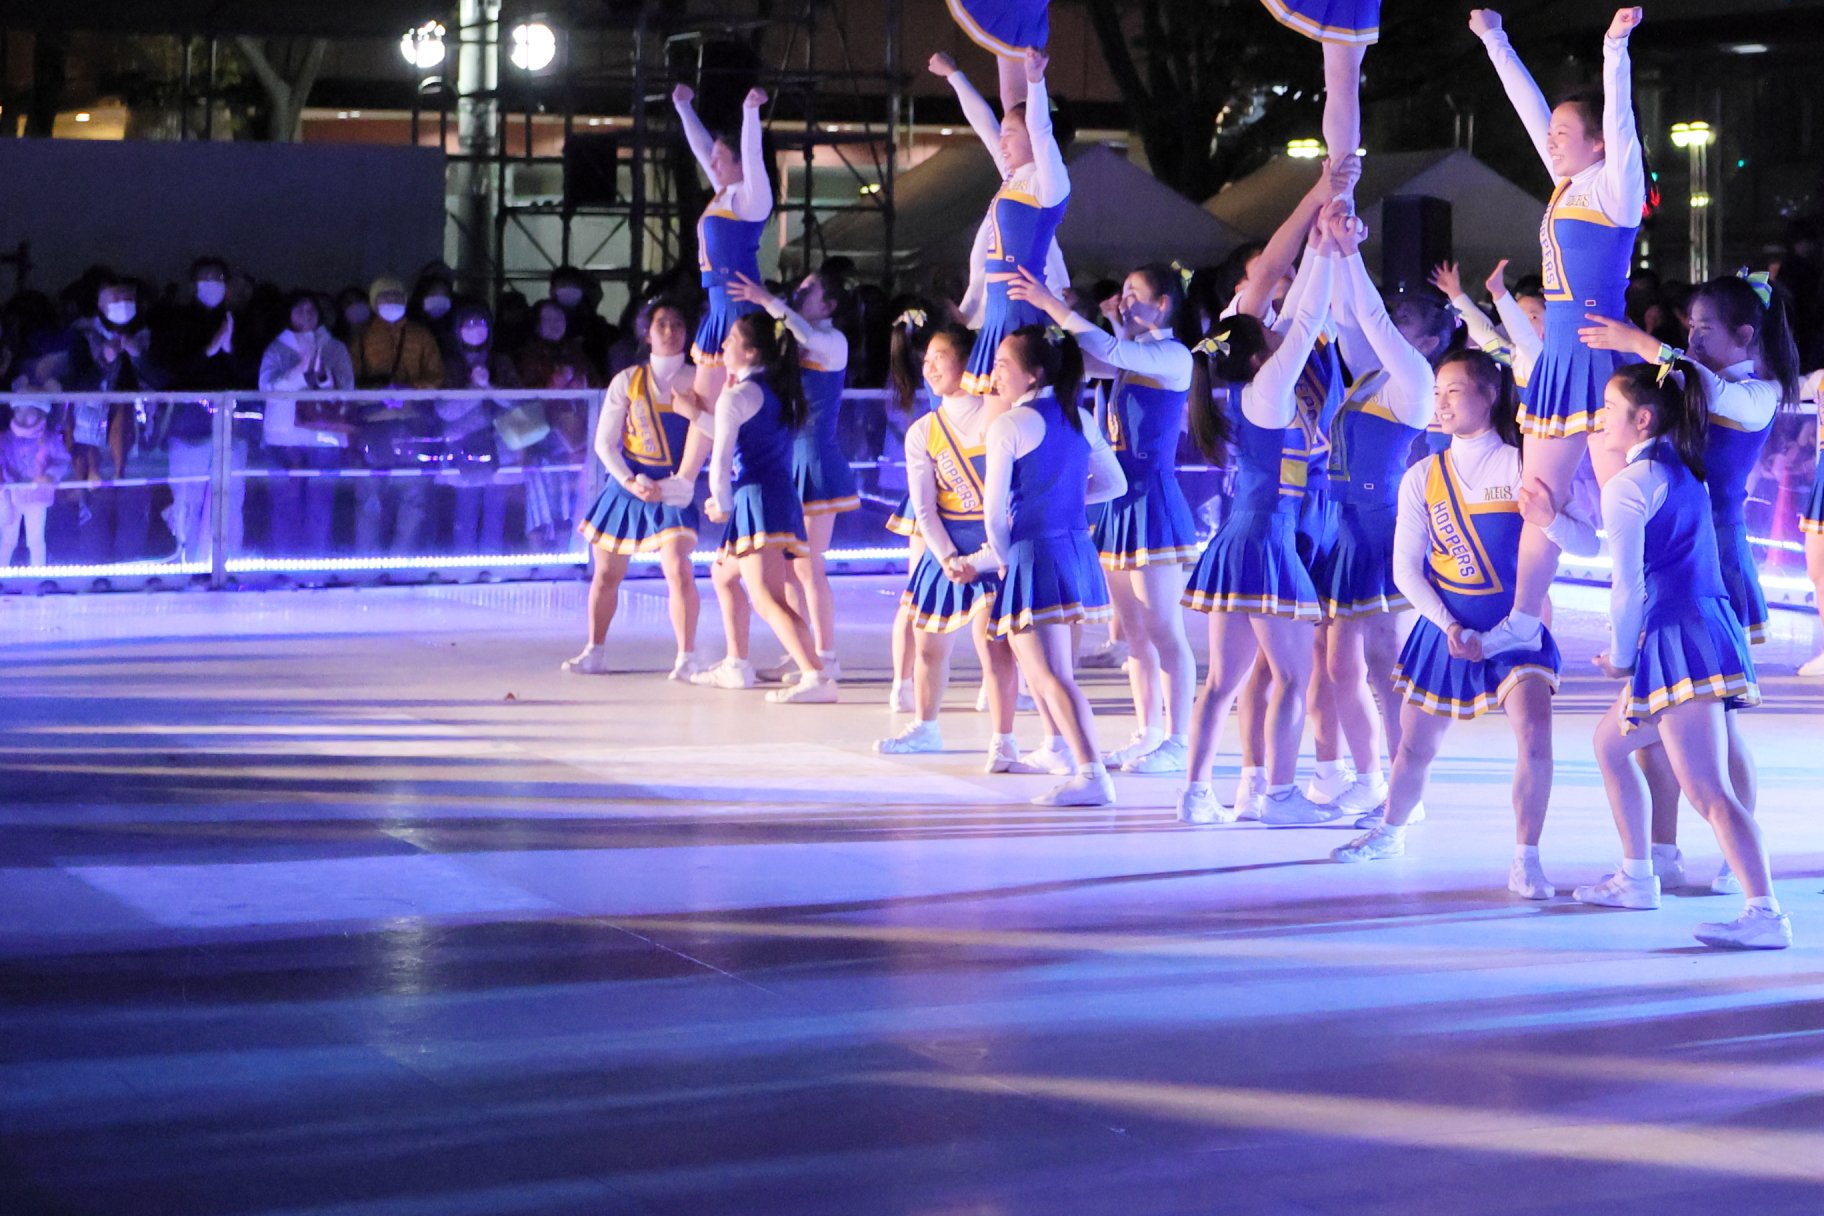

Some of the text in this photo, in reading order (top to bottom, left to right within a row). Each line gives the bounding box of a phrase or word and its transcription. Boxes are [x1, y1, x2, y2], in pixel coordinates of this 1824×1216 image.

[937, 448, 978, 511] HOPPERS
[1484, 486, 1513, 501] MHS
[1431, 500, 1476, 579] HOPPERS
